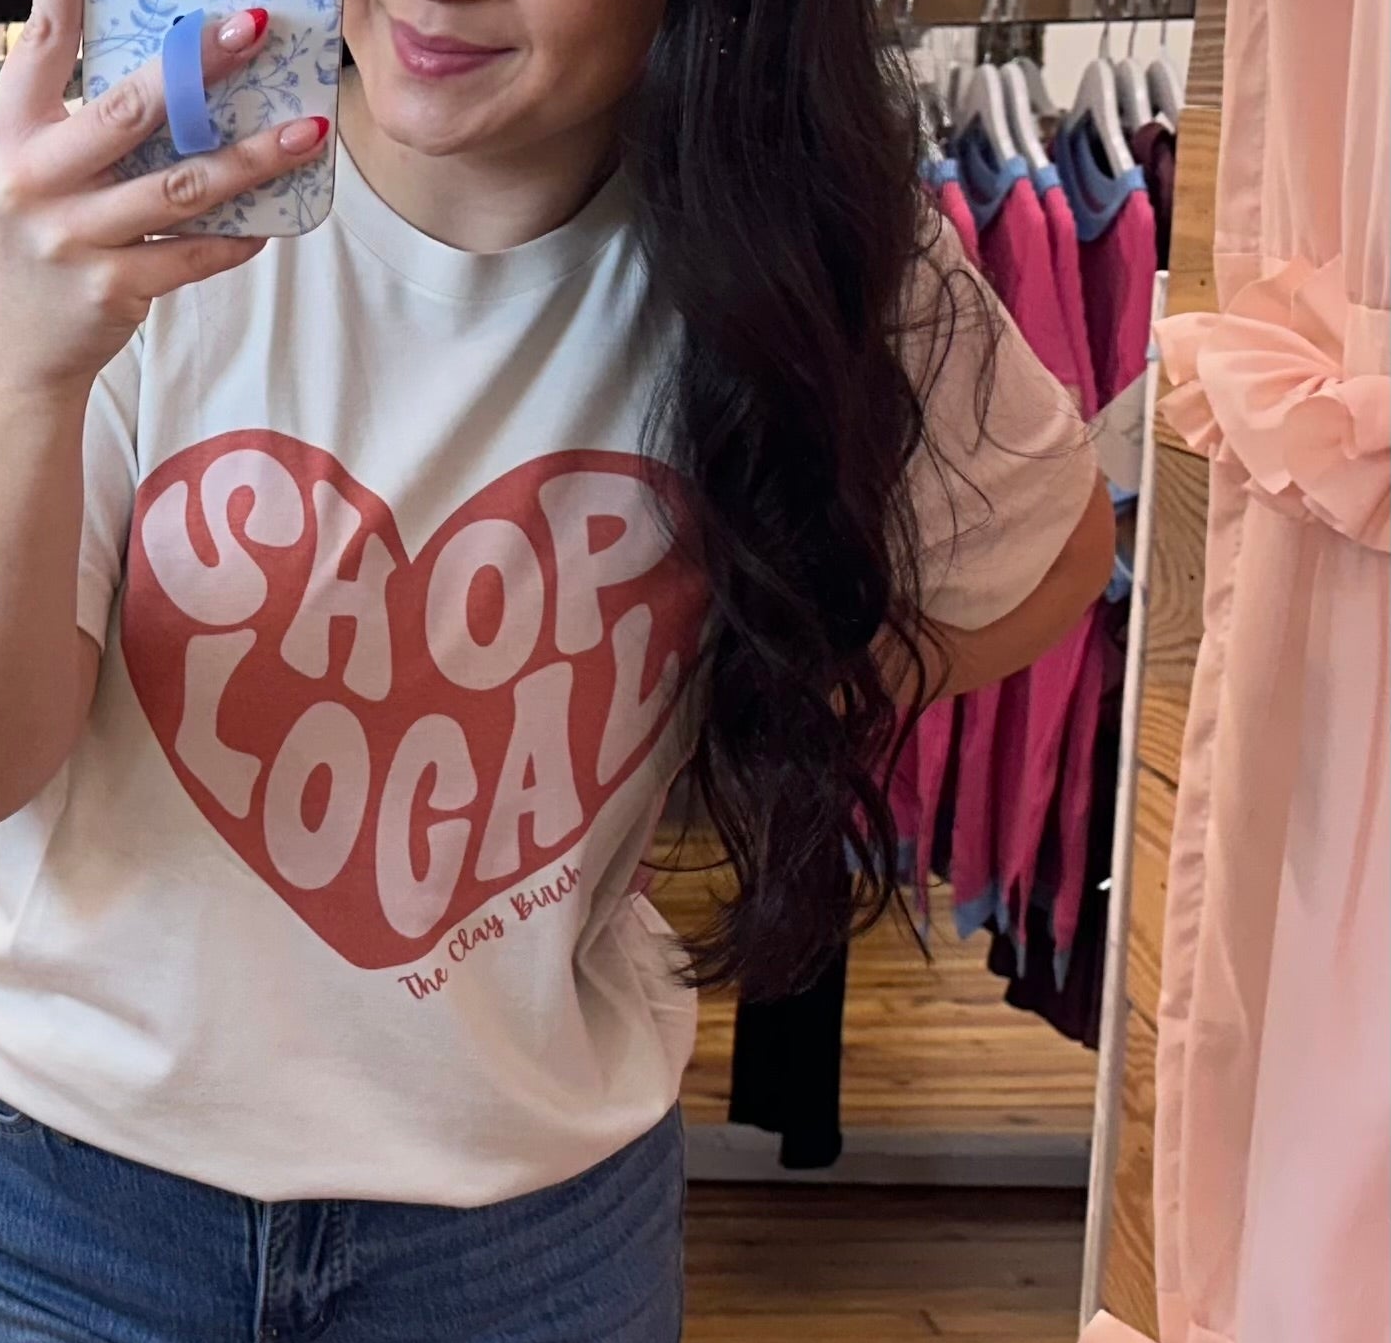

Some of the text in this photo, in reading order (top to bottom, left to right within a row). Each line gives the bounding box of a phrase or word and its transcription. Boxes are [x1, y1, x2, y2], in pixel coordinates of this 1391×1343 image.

[141, 449, 674, 700] SHOP
[174, 603, 680, 938] LOCAL
[397, 864, 583, 1000] The Clay Birch
